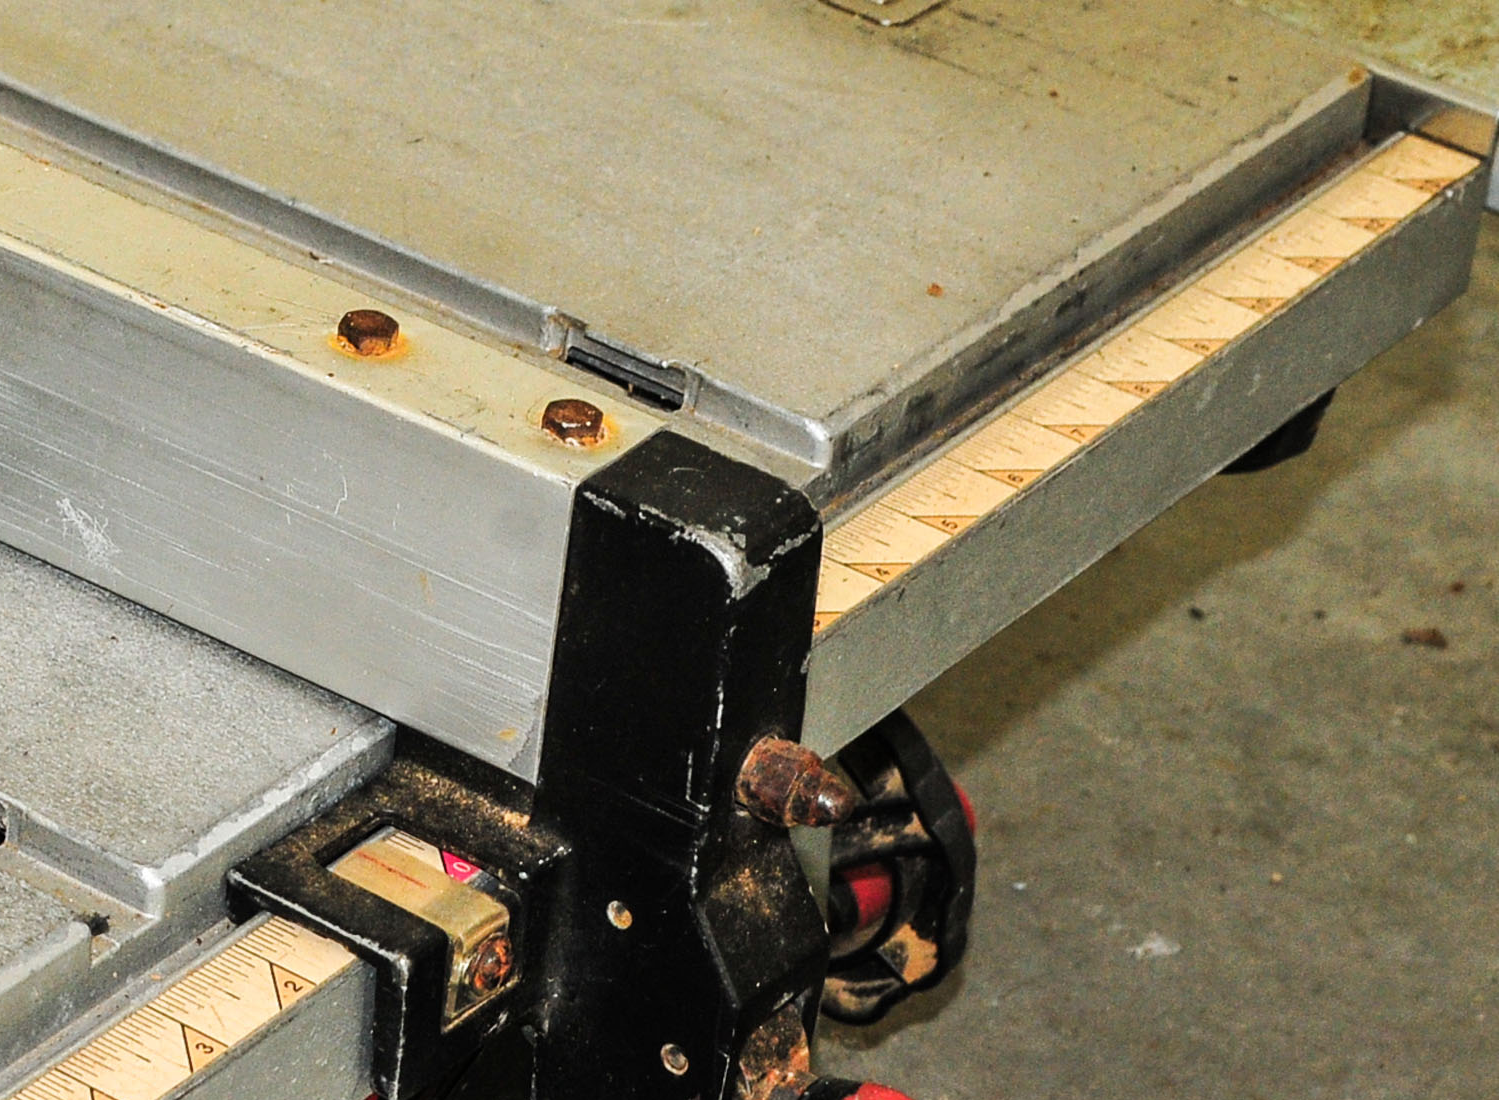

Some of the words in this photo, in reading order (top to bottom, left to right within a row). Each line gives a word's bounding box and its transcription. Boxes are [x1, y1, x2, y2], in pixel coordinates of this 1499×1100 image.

[875, 566, 891, 577] 4
[941, 519, 958, 530] 5
[1071, 427, 1087, 438] 7
[195, 1041, 215, 1055] 3
[283, 979, 304, 993] 2
